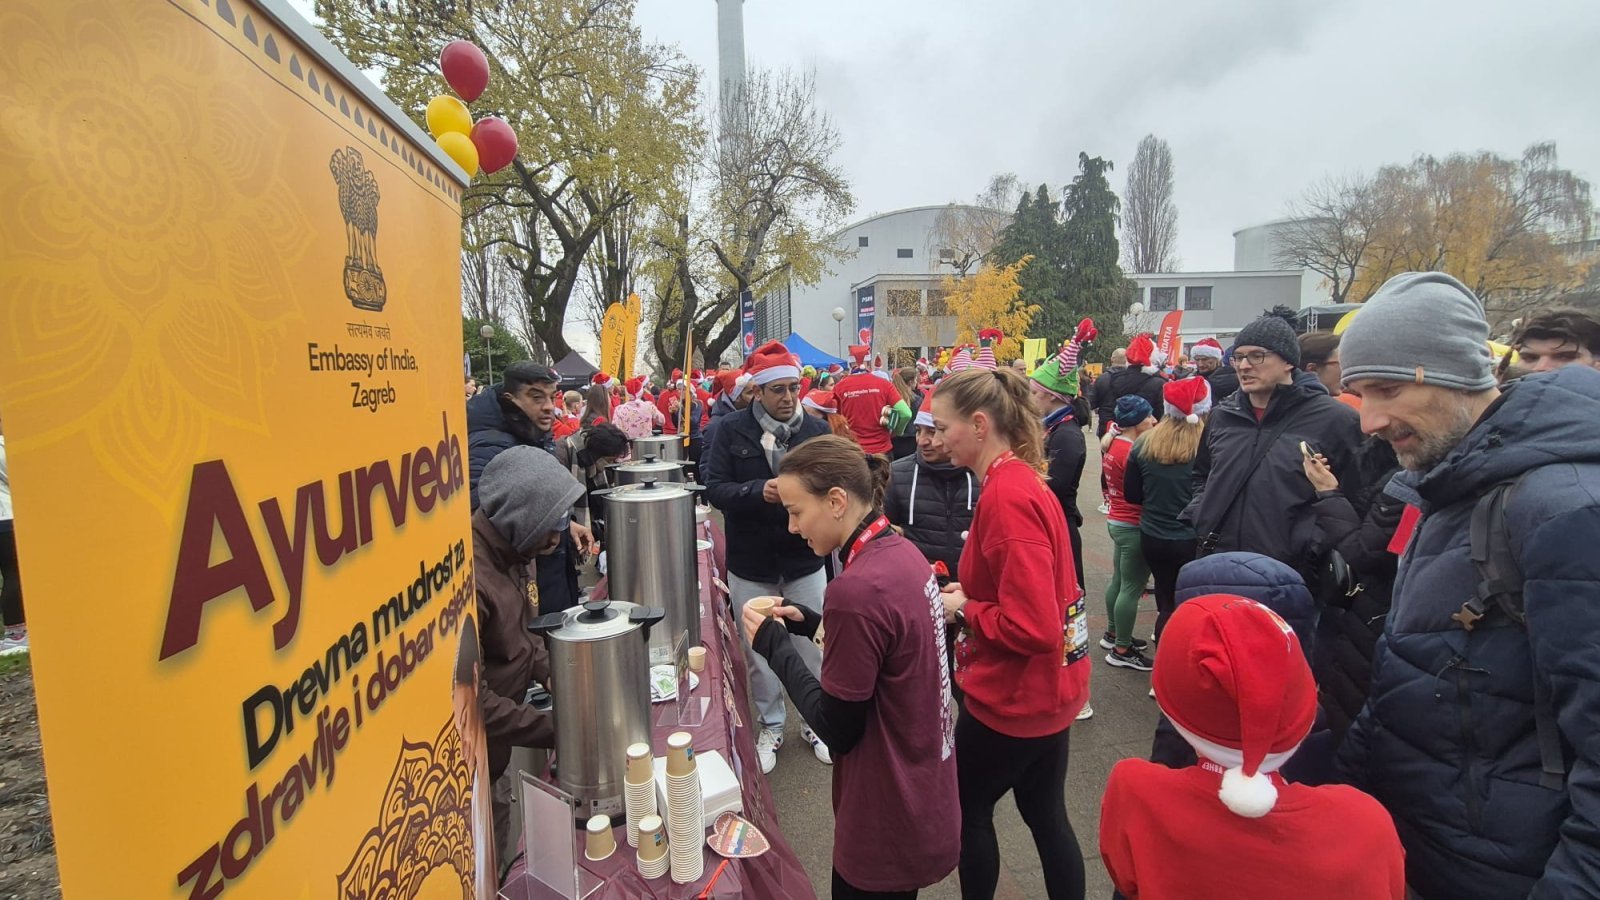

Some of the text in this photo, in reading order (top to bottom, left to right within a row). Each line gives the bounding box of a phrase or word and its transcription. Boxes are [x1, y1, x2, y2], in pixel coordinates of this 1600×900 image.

[307, 342, 418, 378] Embassy of India,
[345, 320, 373, 338] सत्यमेव
[350, 380, 396, 413] Zagreb
[158, 411, 464, 662] Ayurveda
[242, 538, 465, 772] Drevna mudrost za
[177, 704, 350, 900] zdravlje
[351, 674, 363, 728] i
[366, 618, 436, 711] dobar
